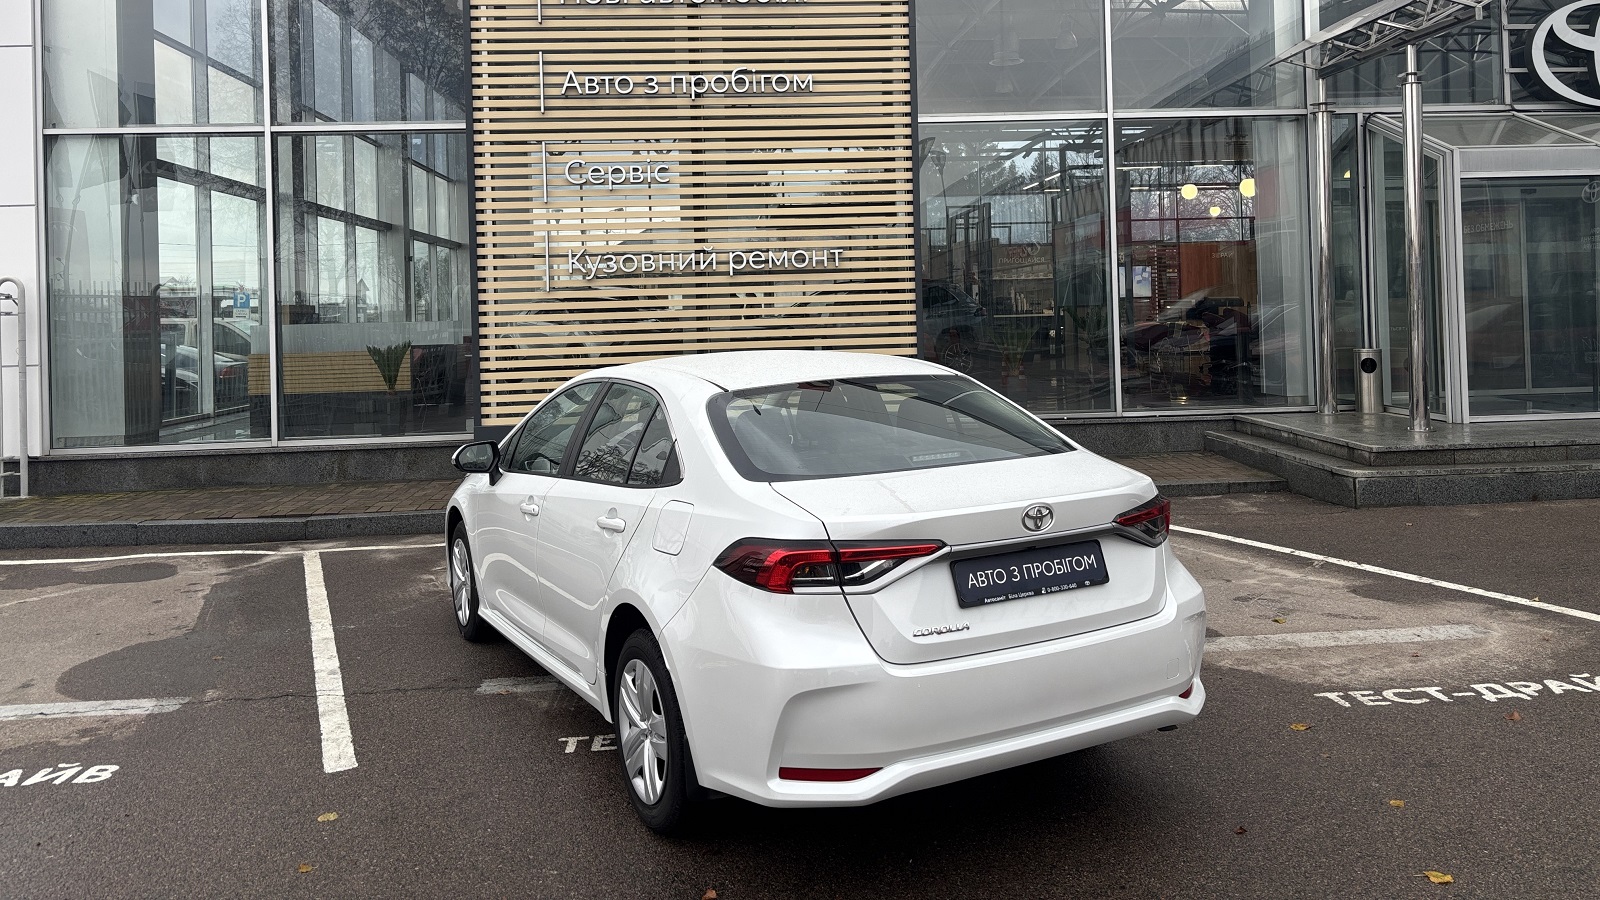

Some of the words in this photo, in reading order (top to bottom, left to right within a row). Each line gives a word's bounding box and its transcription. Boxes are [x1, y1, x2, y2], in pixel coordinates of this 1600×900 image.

[561, 69, 634, 95] Авто
[644, 74, 659, 95] з
[671, 66, 814, 101] пробігом
[565, 158, 670, 191] Сервіс
[568, 245, 717, 280] Кузовний
[729, 249, 844, 278] ремонт
[968, 568, 1007, 589] АВТО
[1010, 566, 1021, 582] З
[1022, 553, 1097, 580] ПРОБІГОМ
[913, 621, 970, 637] COROLLA
